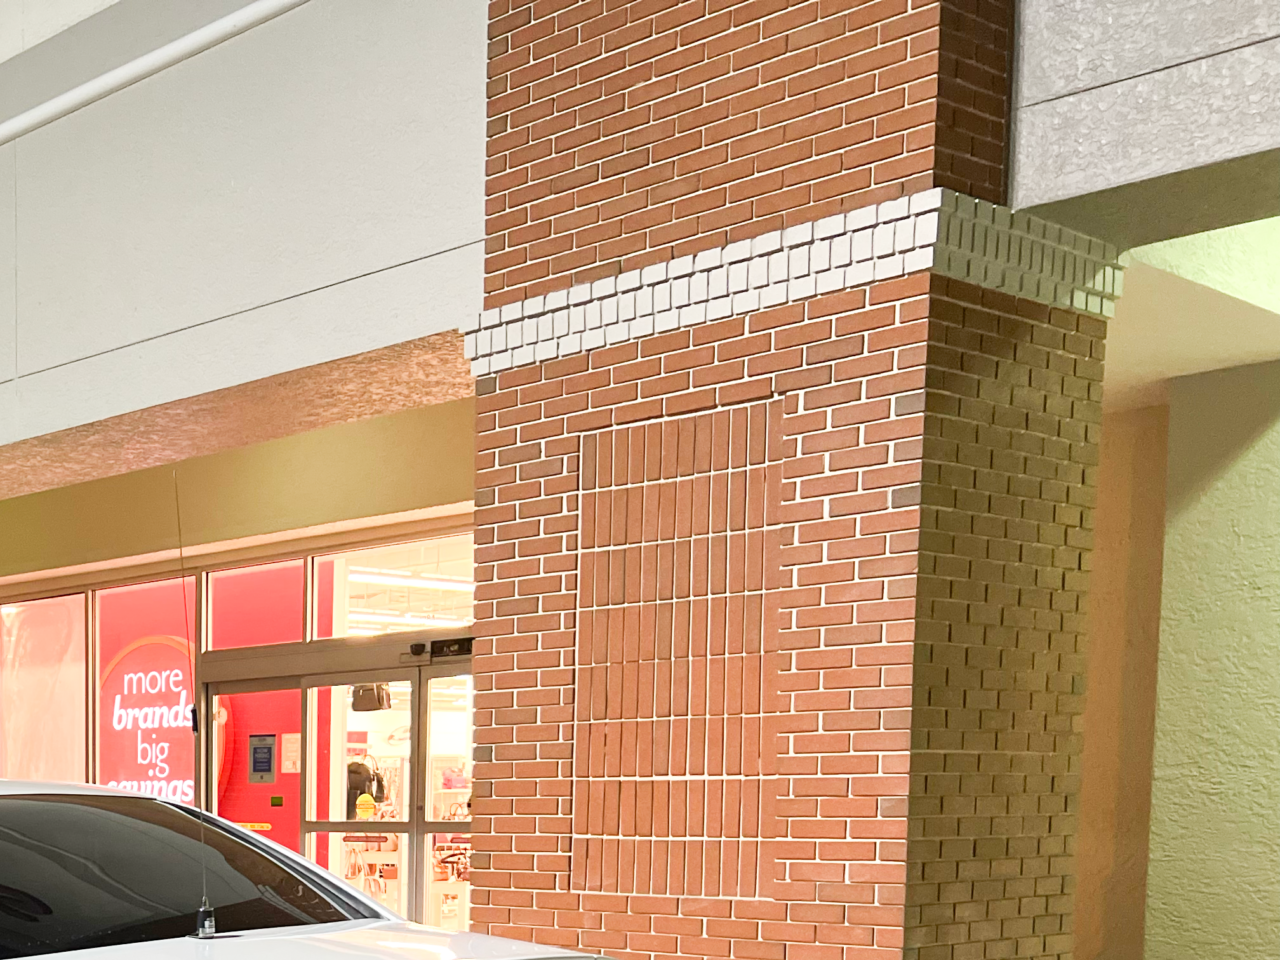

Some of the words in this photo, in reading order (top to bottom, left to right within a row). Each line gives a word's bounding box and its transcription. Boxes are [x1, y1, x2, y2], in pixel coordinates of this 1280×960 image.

[123, 668, 183, 695] more
[112, 689, 195, 730] brands
[137, 729, 170, 778] big
